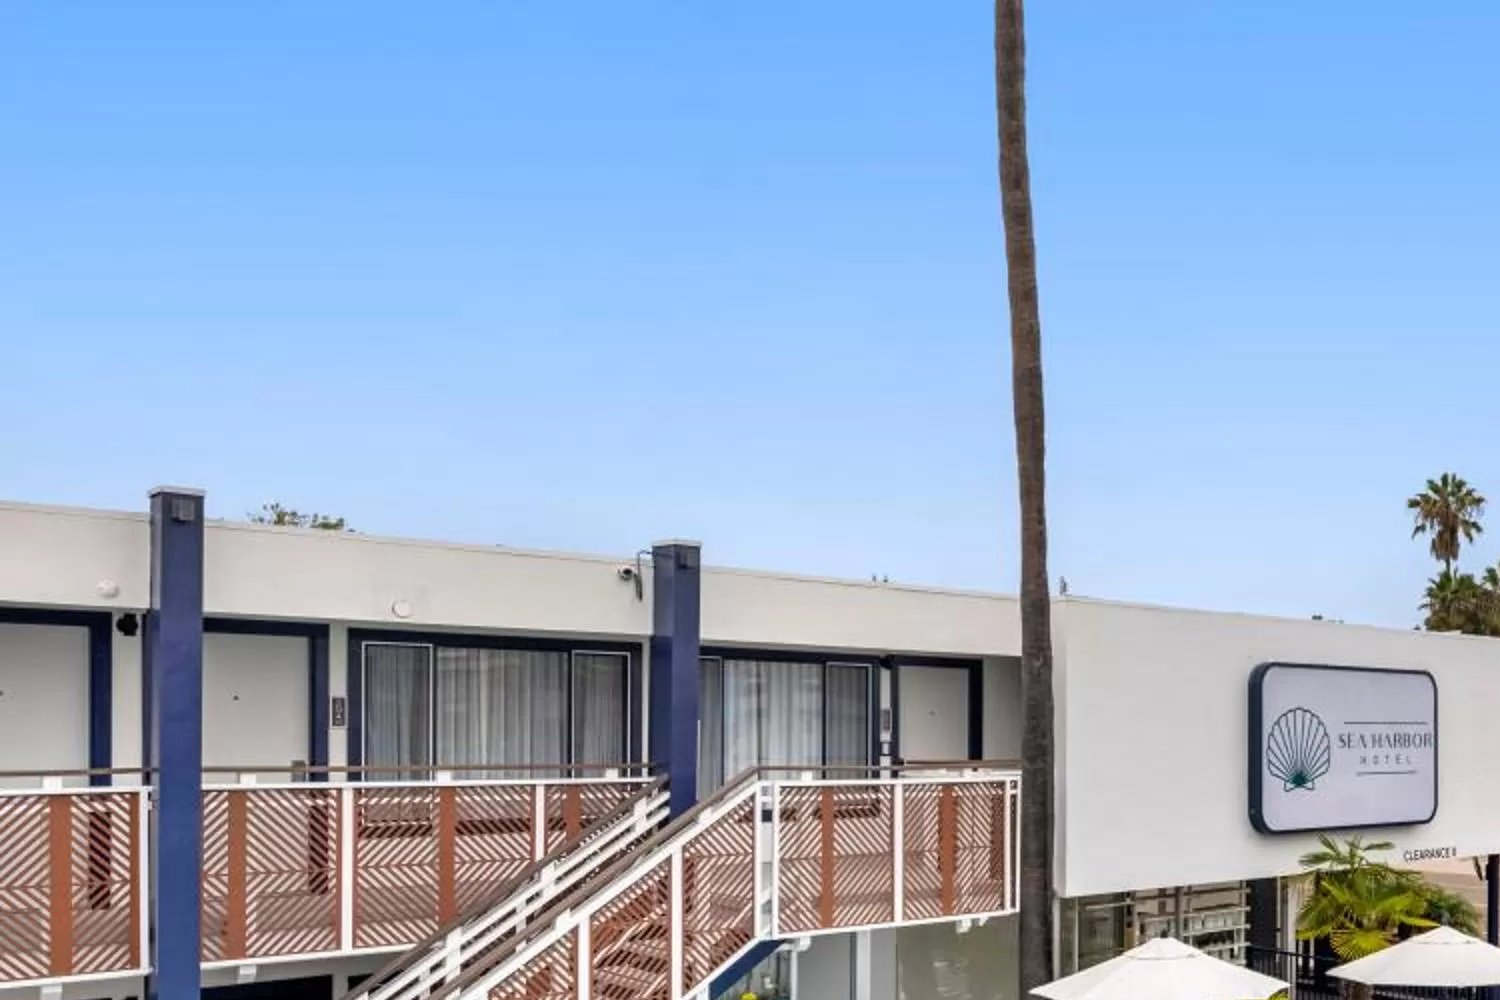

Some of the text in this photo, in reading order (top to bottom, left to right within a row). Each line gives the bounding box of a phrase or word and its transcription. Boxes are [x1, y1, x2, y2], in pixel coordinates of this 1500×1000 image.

[1338, 732, 1432, 749] SEA HARBOR
[1360, 755, 1412, 765] HOTEL
[1403, 847, 1450, 862] CLEARANCE
